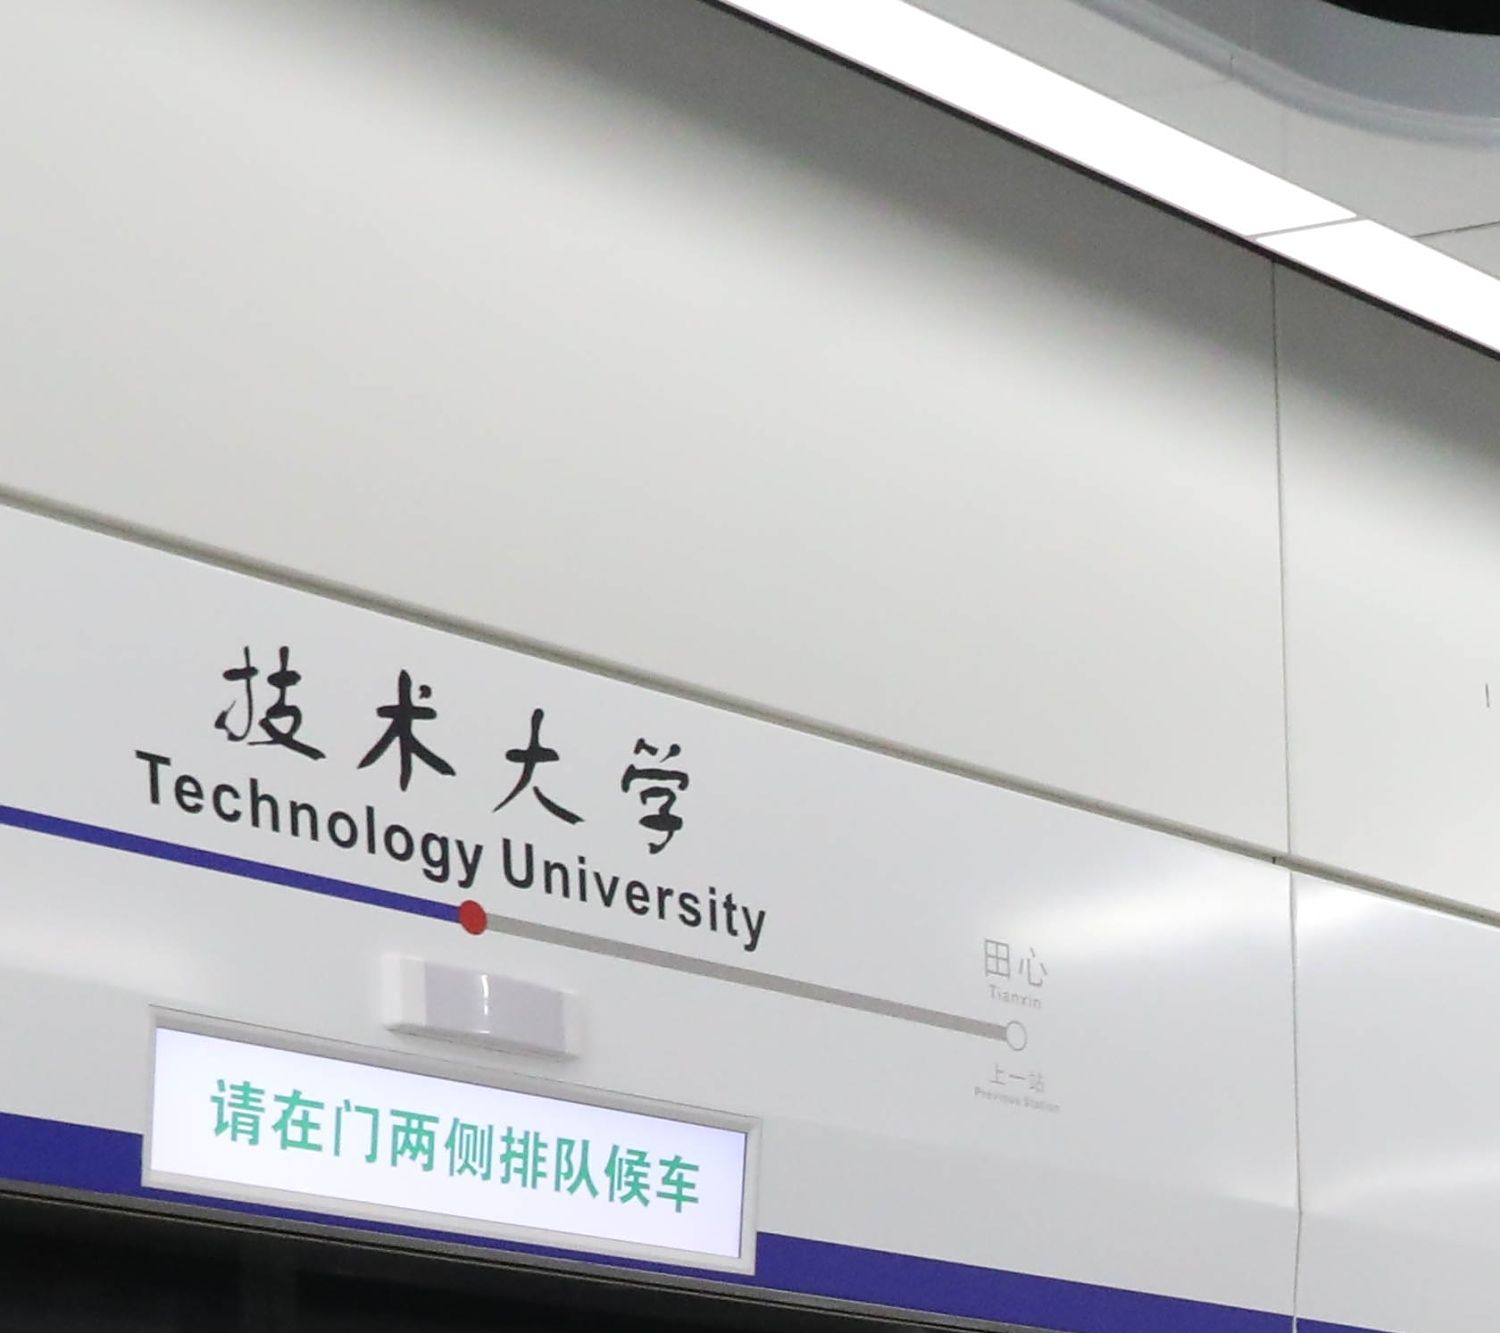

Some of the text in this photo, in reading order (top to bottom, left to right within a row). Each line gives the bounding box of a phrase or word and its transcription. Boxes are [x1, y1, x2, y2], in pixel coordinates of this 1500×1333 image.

[214, 645, 691, 855] 技术大学
[134, 749, 767, 953] Technology University
[984, 937, 1048, 987] 田心
[210, 1078, 700, 1213] 请在门两侧排队候车
